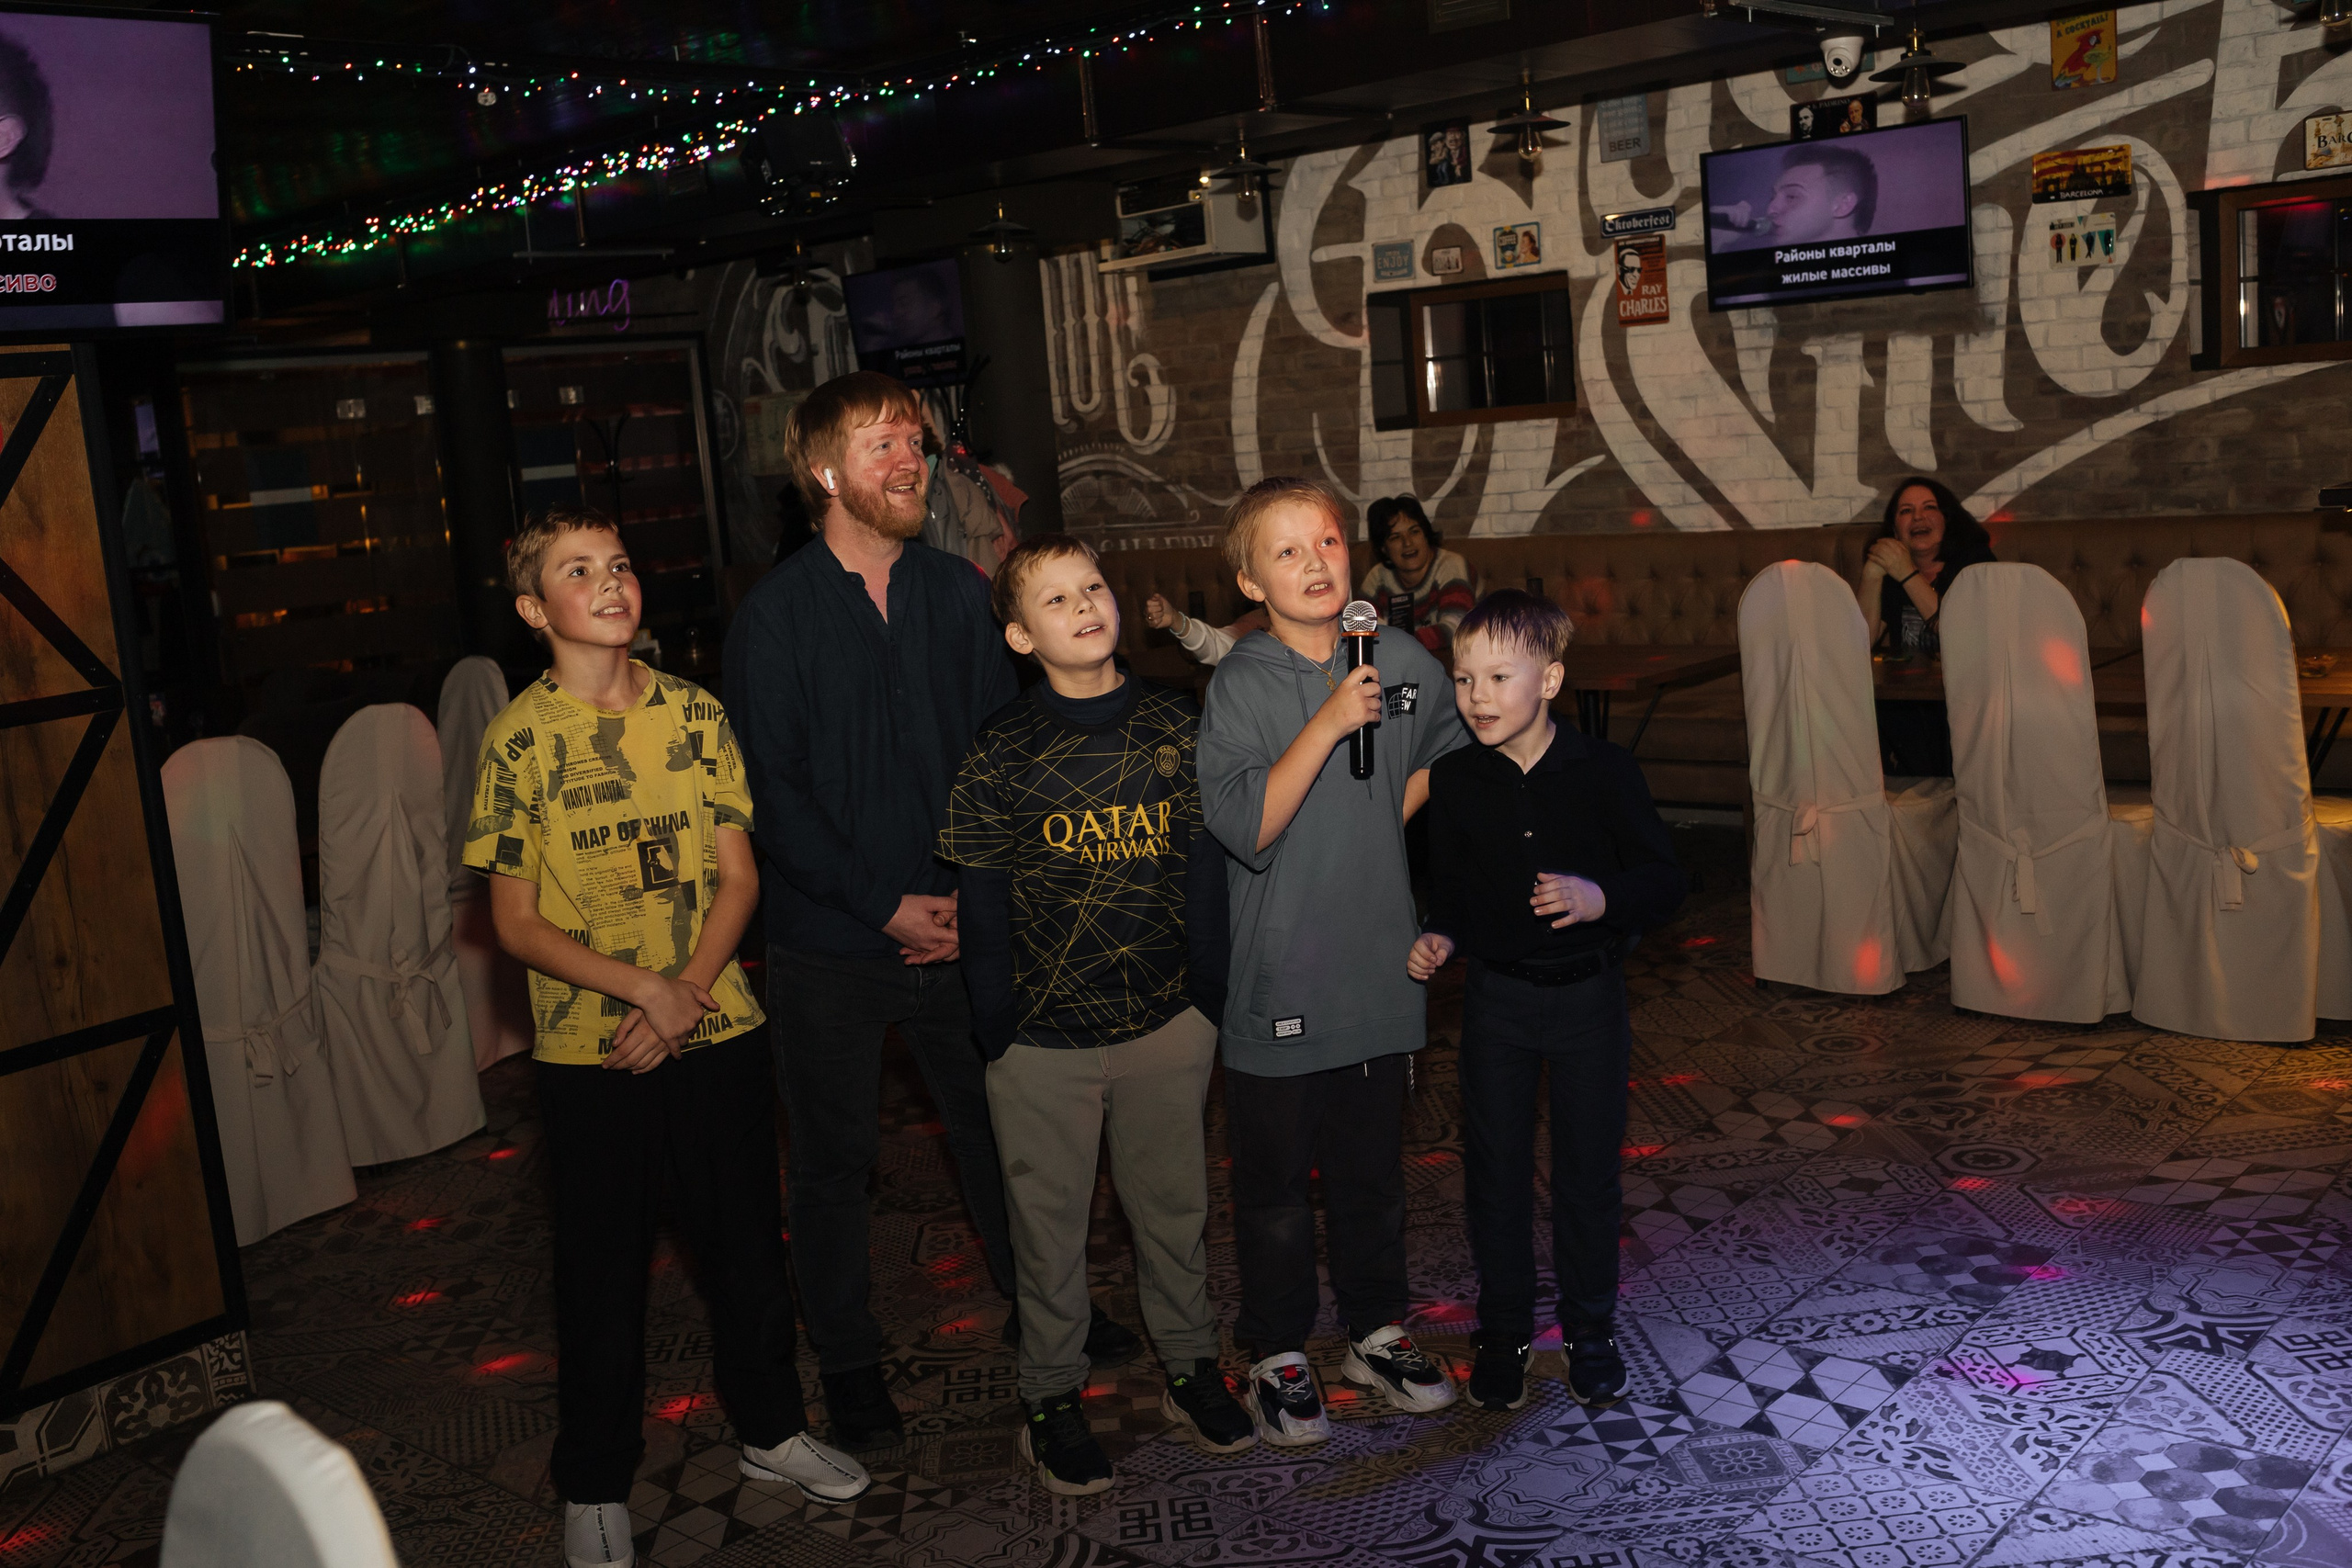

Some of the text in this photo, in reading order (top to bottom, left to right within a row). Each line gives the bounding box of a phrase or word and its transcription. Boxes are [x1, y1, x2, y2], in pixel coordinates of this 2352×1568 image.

[1609, 137, 1642, 152] BEER
[2059, 188, 2104, 199] BARCELONA
[1604, 214, 1670, 232] Oktoberfest
[0, 233, 74, 252] талы
[1775, 241, 1895, 264] Районы кварталы
[1377, 255, 1410, 269] ENJOY
[1781, 264, 1891, 284] жилые массивы
[1641, 283, 1663, 295] RAY
[1619, 296, 1668, 318] CHARLES
[1401, 687, 1418, 699] FAR
[560, 776, 585, 784] ATTITUDE
[570, 766, 603, 777] DIVERSIFIED
[560, 778, 625, 810] WANTAI WANTAI
[571, 825, 611, 851] MAP
[616, 818, 641, 841] OF
[643, 810, 691, 836] CHINA
[1043, 801, 1170, 852] QATAR
[1079, 835, 1170, 864] AIRWAYS
